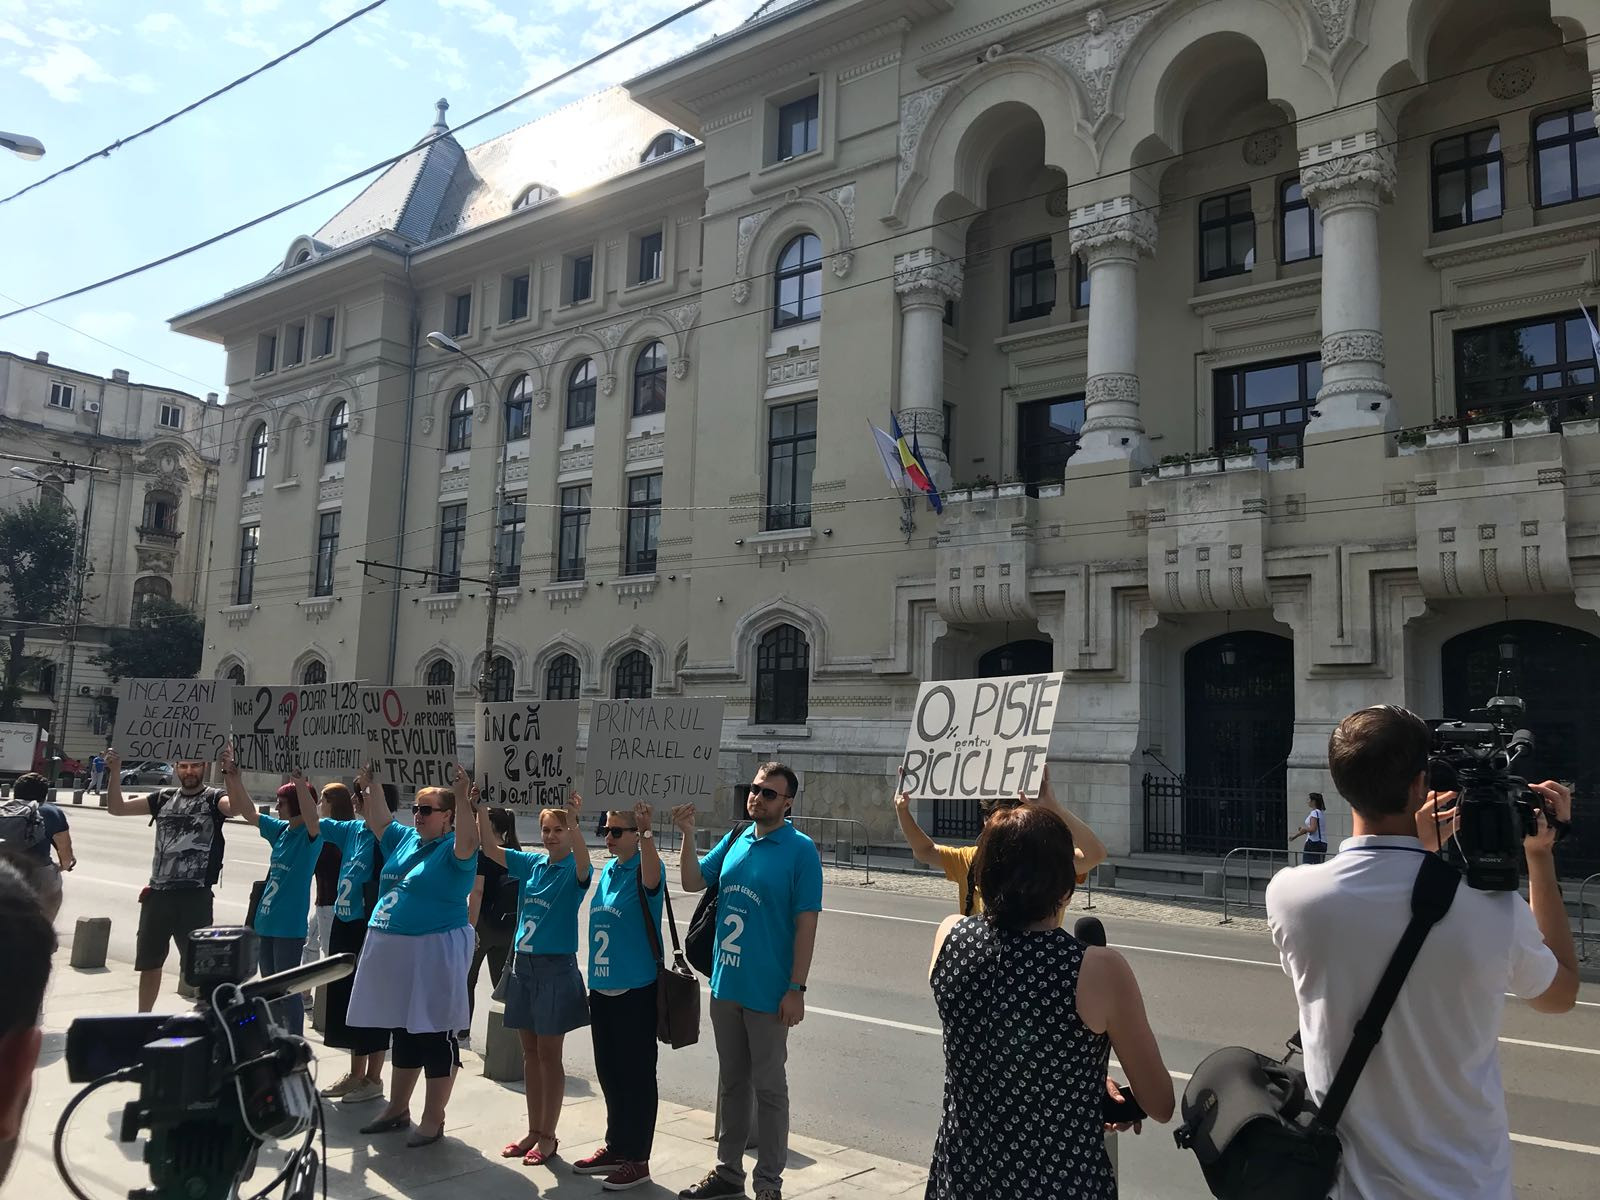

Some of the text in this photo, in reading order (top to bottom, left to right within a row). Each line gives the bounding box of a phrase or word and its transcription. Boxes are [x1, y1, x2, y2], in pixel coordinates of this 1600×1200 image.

[171, 683, 187, 703] 2
[187, 681, 217, 703] ANI
[300, 689, 327, 713] DOAR
[362, 692, 380, 714] CU
[426, 687, 447, 706] MAI
[143, 705, 200, 721] DE ZERO
[253, 686, 275, 734] 2
[414, 711, 455, 727] APROAPE
[596, 700, 705, 733] PRIMARUL
[968, 675, 1060, 741] PISTE
[367, 729, 379, 741] DE
[483, 703, 541, 742] ÎNCĂ
[273, 735, 299, 752] VORBE
[610, 737, 713, 761] PARALEL CU
[954, 735, 992, 751] pentru
[384, 758, 455, 786] TRAFIC
[503, 744, 563, 782] 2 ani
[899, 744, 1048, 798] BICICLETE
[478, 772, 496, 804] de
[498, 781, 533, 806] bani
[263, 880, 279, 905] 2
[338, 878, 352, 906] 2
[518, 919, 537, 953] 2
[594, 930, 610, 965] 2
[721, 913, 745, 955] 2
[594, 966, 609, 977] ANI
[720, 952, 740, 968] ANI
